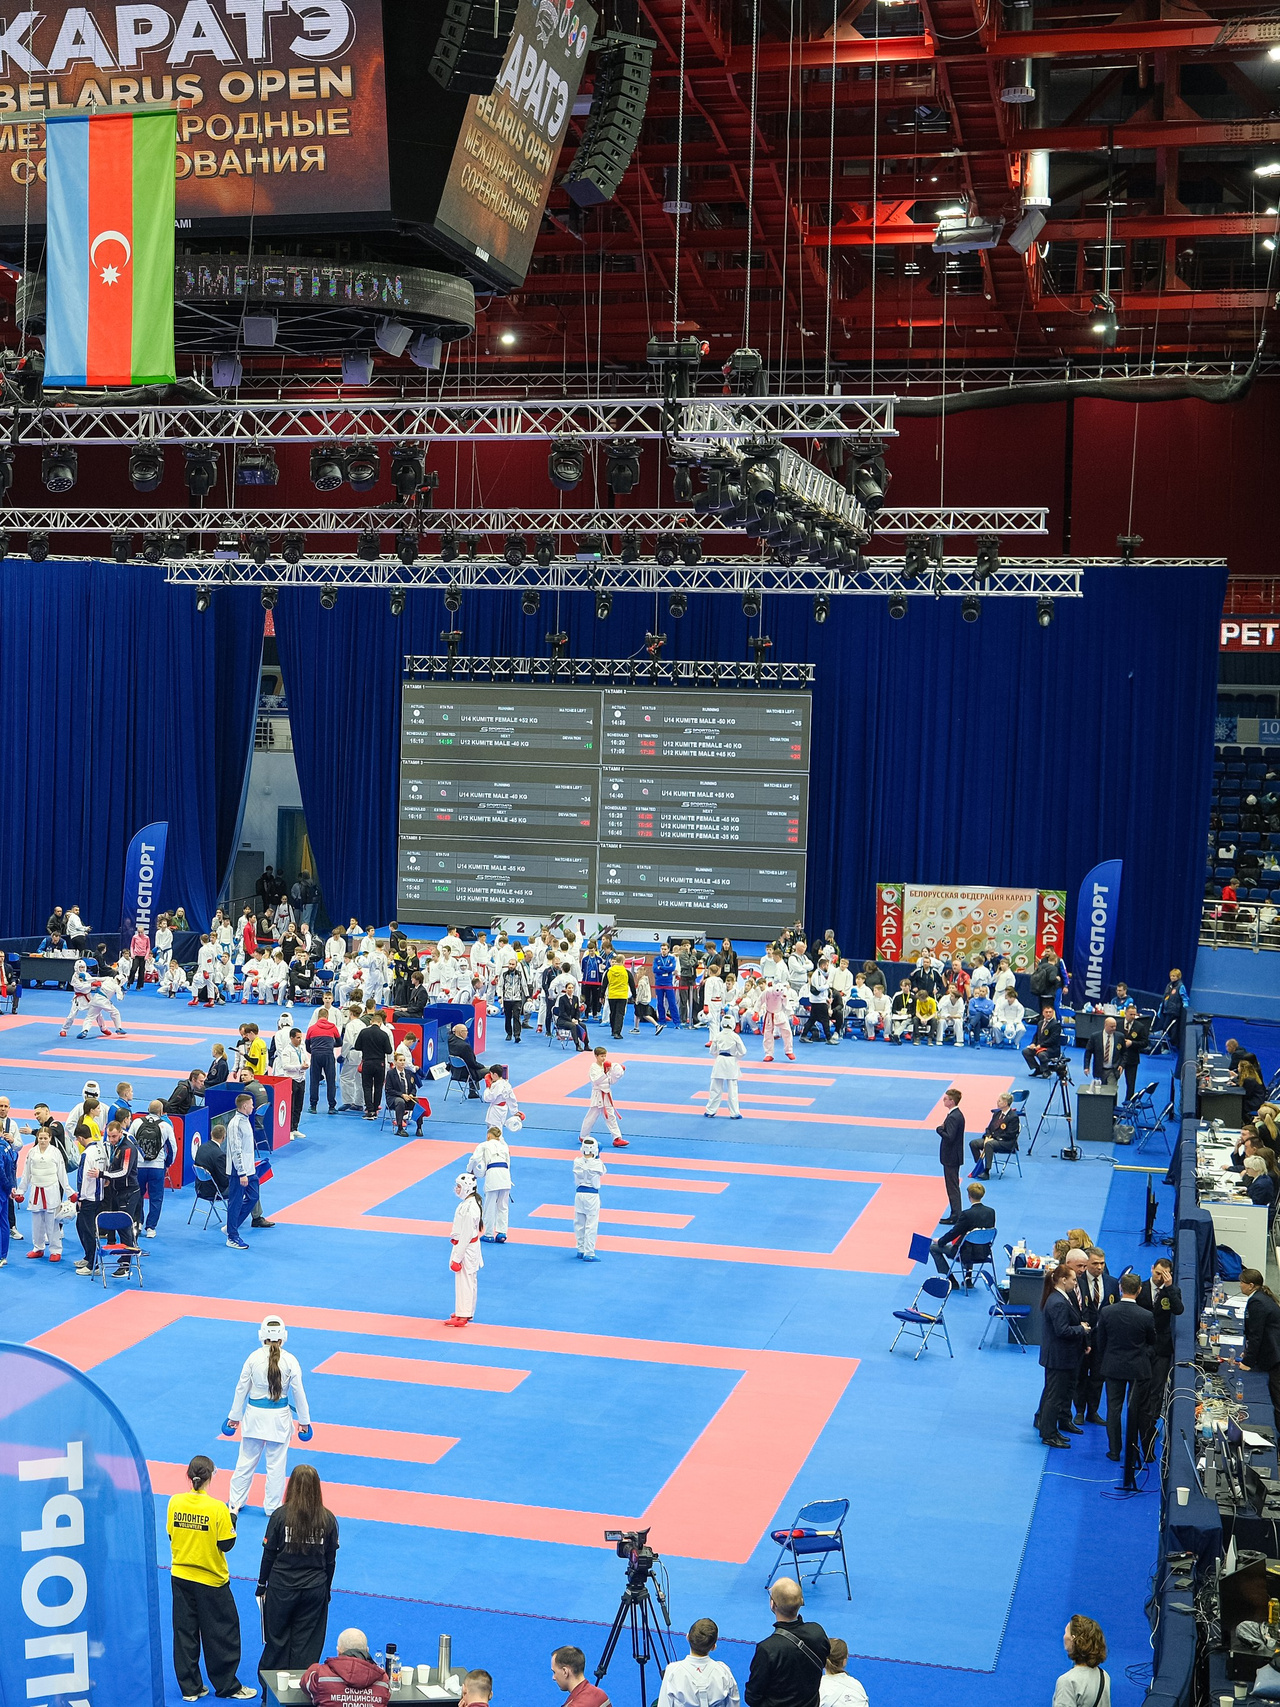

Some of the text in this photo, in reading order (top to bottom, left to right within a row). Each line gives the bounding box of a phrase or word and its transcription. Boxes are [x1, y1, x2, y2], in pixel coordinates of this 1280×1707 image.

[219, 65, 353, 103] OPEN
[496, 34, 569, 142] АРАТЭ
[475, 95, 555, 177] BELARUS OPEN
[11, 145, 326, 182] СОВАНИЯ
[463, 129, 543, 208] МЕЖДУНАРОДНЫЕ
[460, 163, 530, 234] СОРЕВНОВАНИЯ
[135, 842, 156, 935] ІНСПОРТ
[909, 890, 1032, 902] БЕЛОРУССКАЯ ФЕДЕРАЦИЯ КАРАТЭ
[516, 921, 525, 933] 2
[578, 919, 586, 936] 1
[653, 933, 660, 941] 3
[881, 905, 897, 961] КАРАТ
[1084, 883, 1109, 999] МІНСПОРТ
[173, 1511, 209, 1525] ВОЛОНТЕР
[331, 1694, 382, 1704] МЕДИЦИНСКАЯ
[345, 1687, 373, 1695] СКОРАЯ
